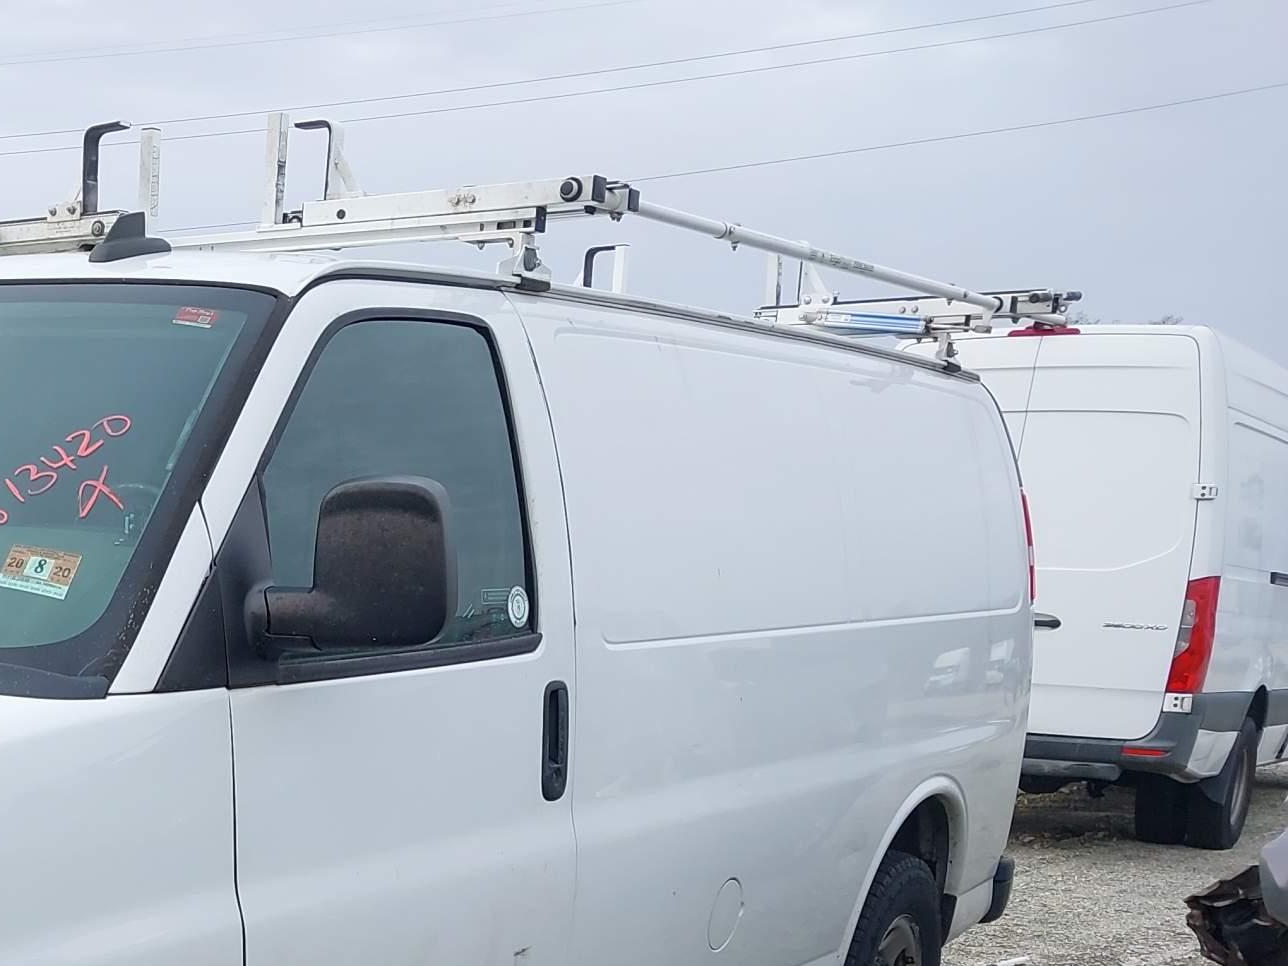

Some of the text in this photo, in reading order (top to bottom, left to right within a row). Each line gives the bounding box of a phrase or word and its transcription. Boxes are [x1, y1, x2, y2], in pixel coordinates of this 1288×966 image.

[7, 556, 72, 579] 20 8 20
